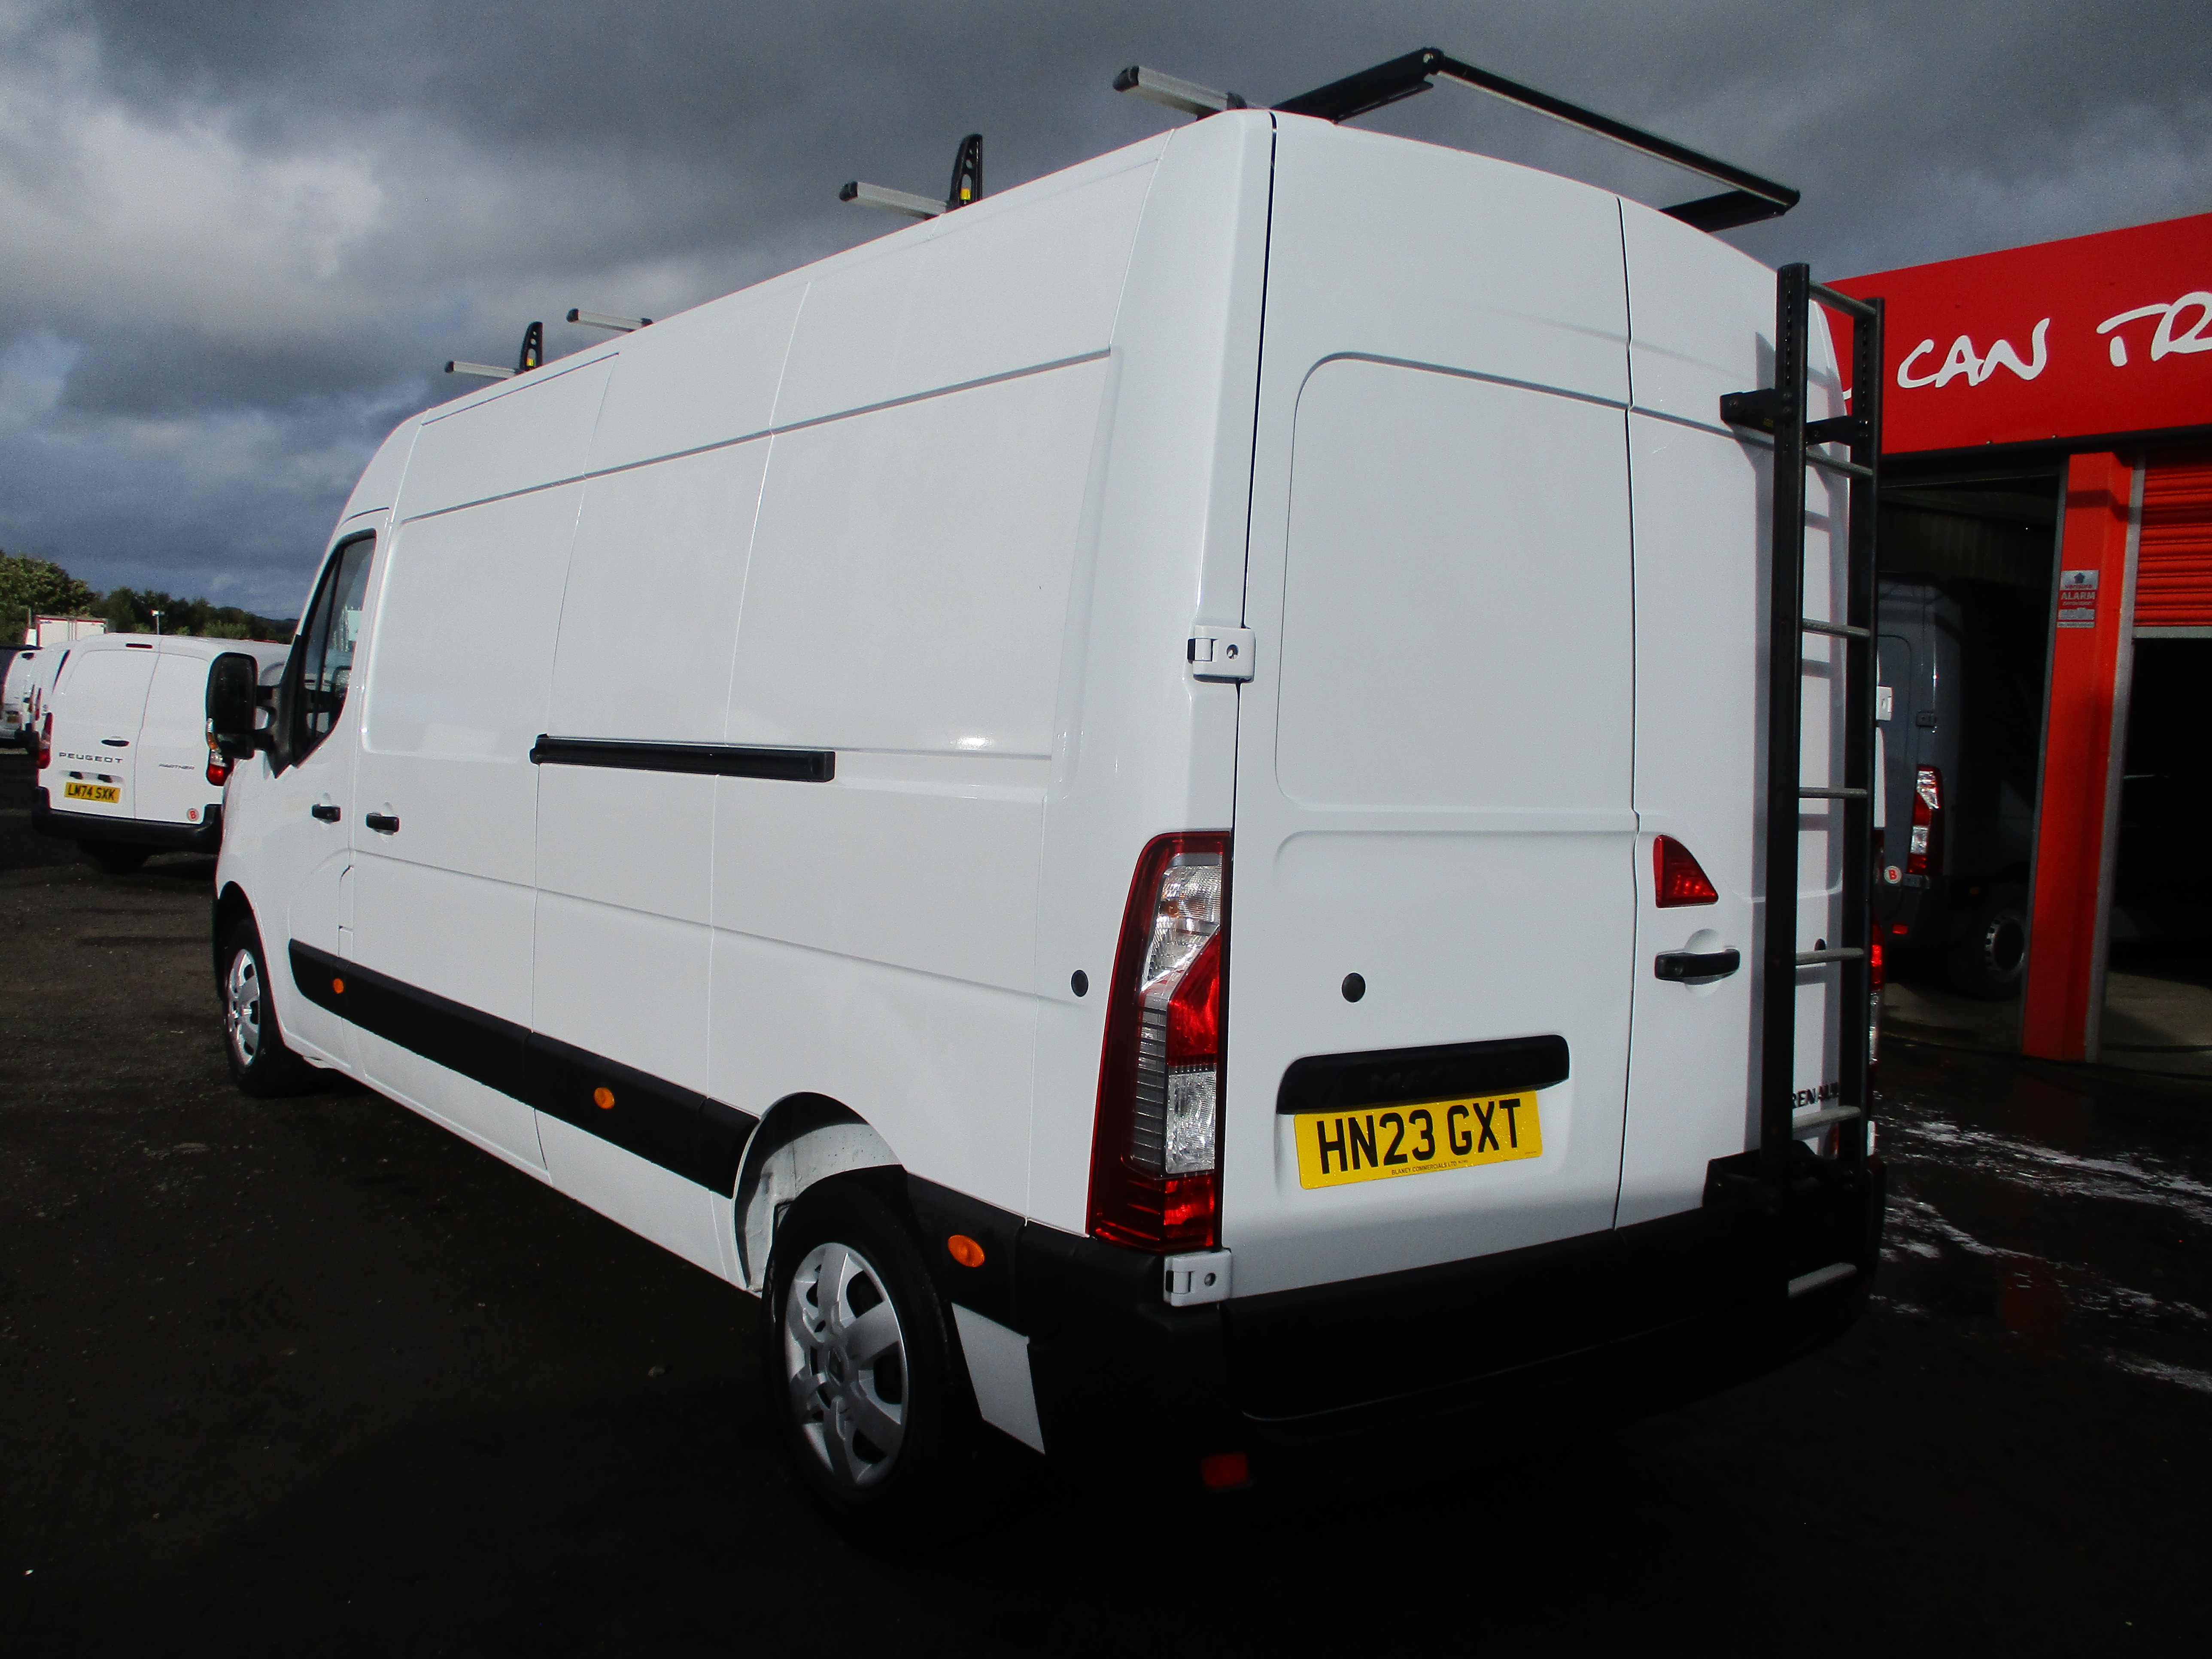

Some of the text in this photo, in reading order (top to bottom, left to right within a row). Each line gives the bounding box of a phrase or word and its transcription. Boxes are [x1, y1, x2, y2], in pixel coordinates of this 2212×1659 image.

[1897, 318, 2050, 388] CAN
[59, 752, 123, 763] PEUGEOT
[95, 787, 115, 801] SXK
[190, 810, 196, 819] B
[1888, 869, 1897, 880] B
[1316, 1098, 1521, 1175] HN23 GXT
[1412, 1162, 1447, 1172] COMMERCIALS
